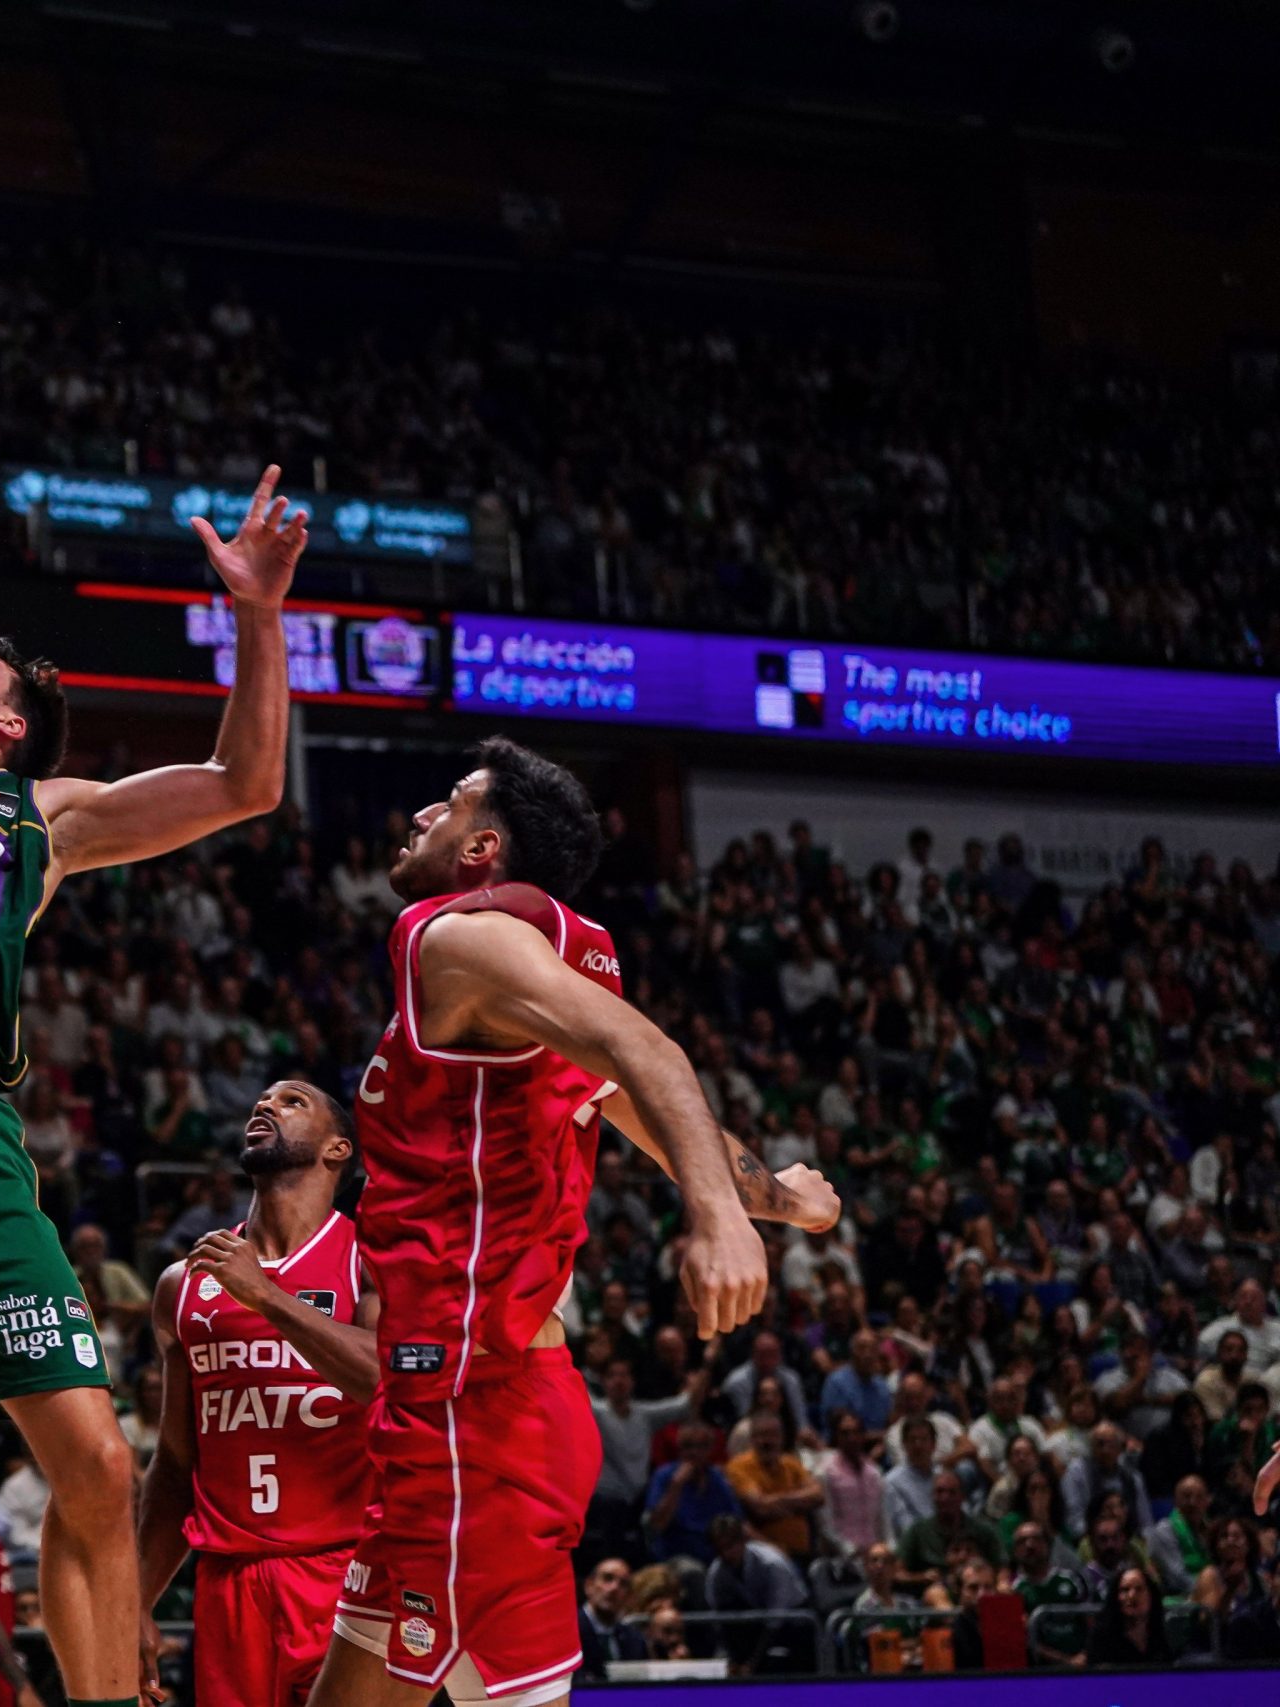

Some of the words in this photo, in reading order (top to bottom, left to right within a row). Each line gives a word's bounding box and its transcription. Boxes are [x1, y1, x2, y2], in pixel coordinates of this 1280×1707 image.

[453, 624, 494, 664] La
[480, 666, 635, 711] deportiva
[842, 653, 898, 694] The
[905, 666, 982, 701] most
[842, 699, 967, 737] sportive
[975, 703, 1072, 743] choice
[7, 1296, 62, 1332] má
[0, 1328, 65, 1360] laga
[200, 1386, 343, 1434] FIATC
[248, 1454, 280, 1514] 5
